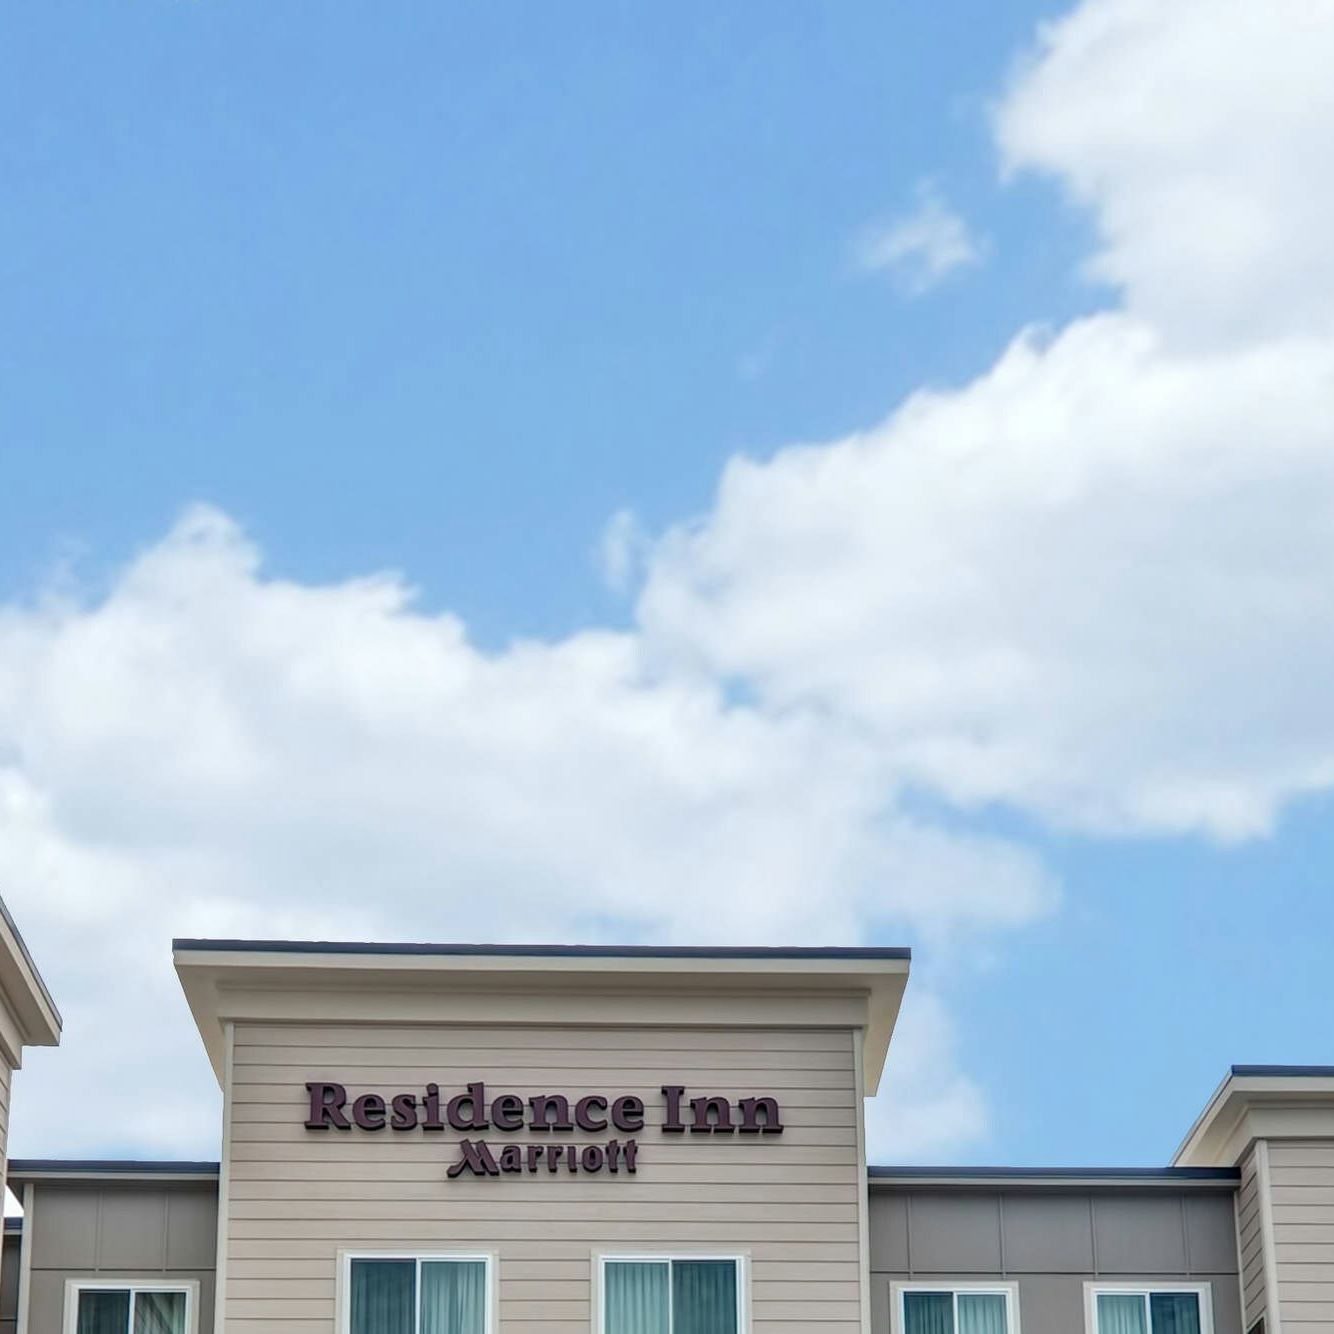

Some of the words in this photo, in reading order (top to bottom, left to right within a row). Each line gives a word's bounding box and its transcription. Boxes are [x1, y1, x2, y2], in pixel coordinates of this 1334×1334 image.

[304, 1081, 645, 1132] Residence
[661, 1085, 784, 1134] Inn
[447, 1138, 638, 1178] Marriott
